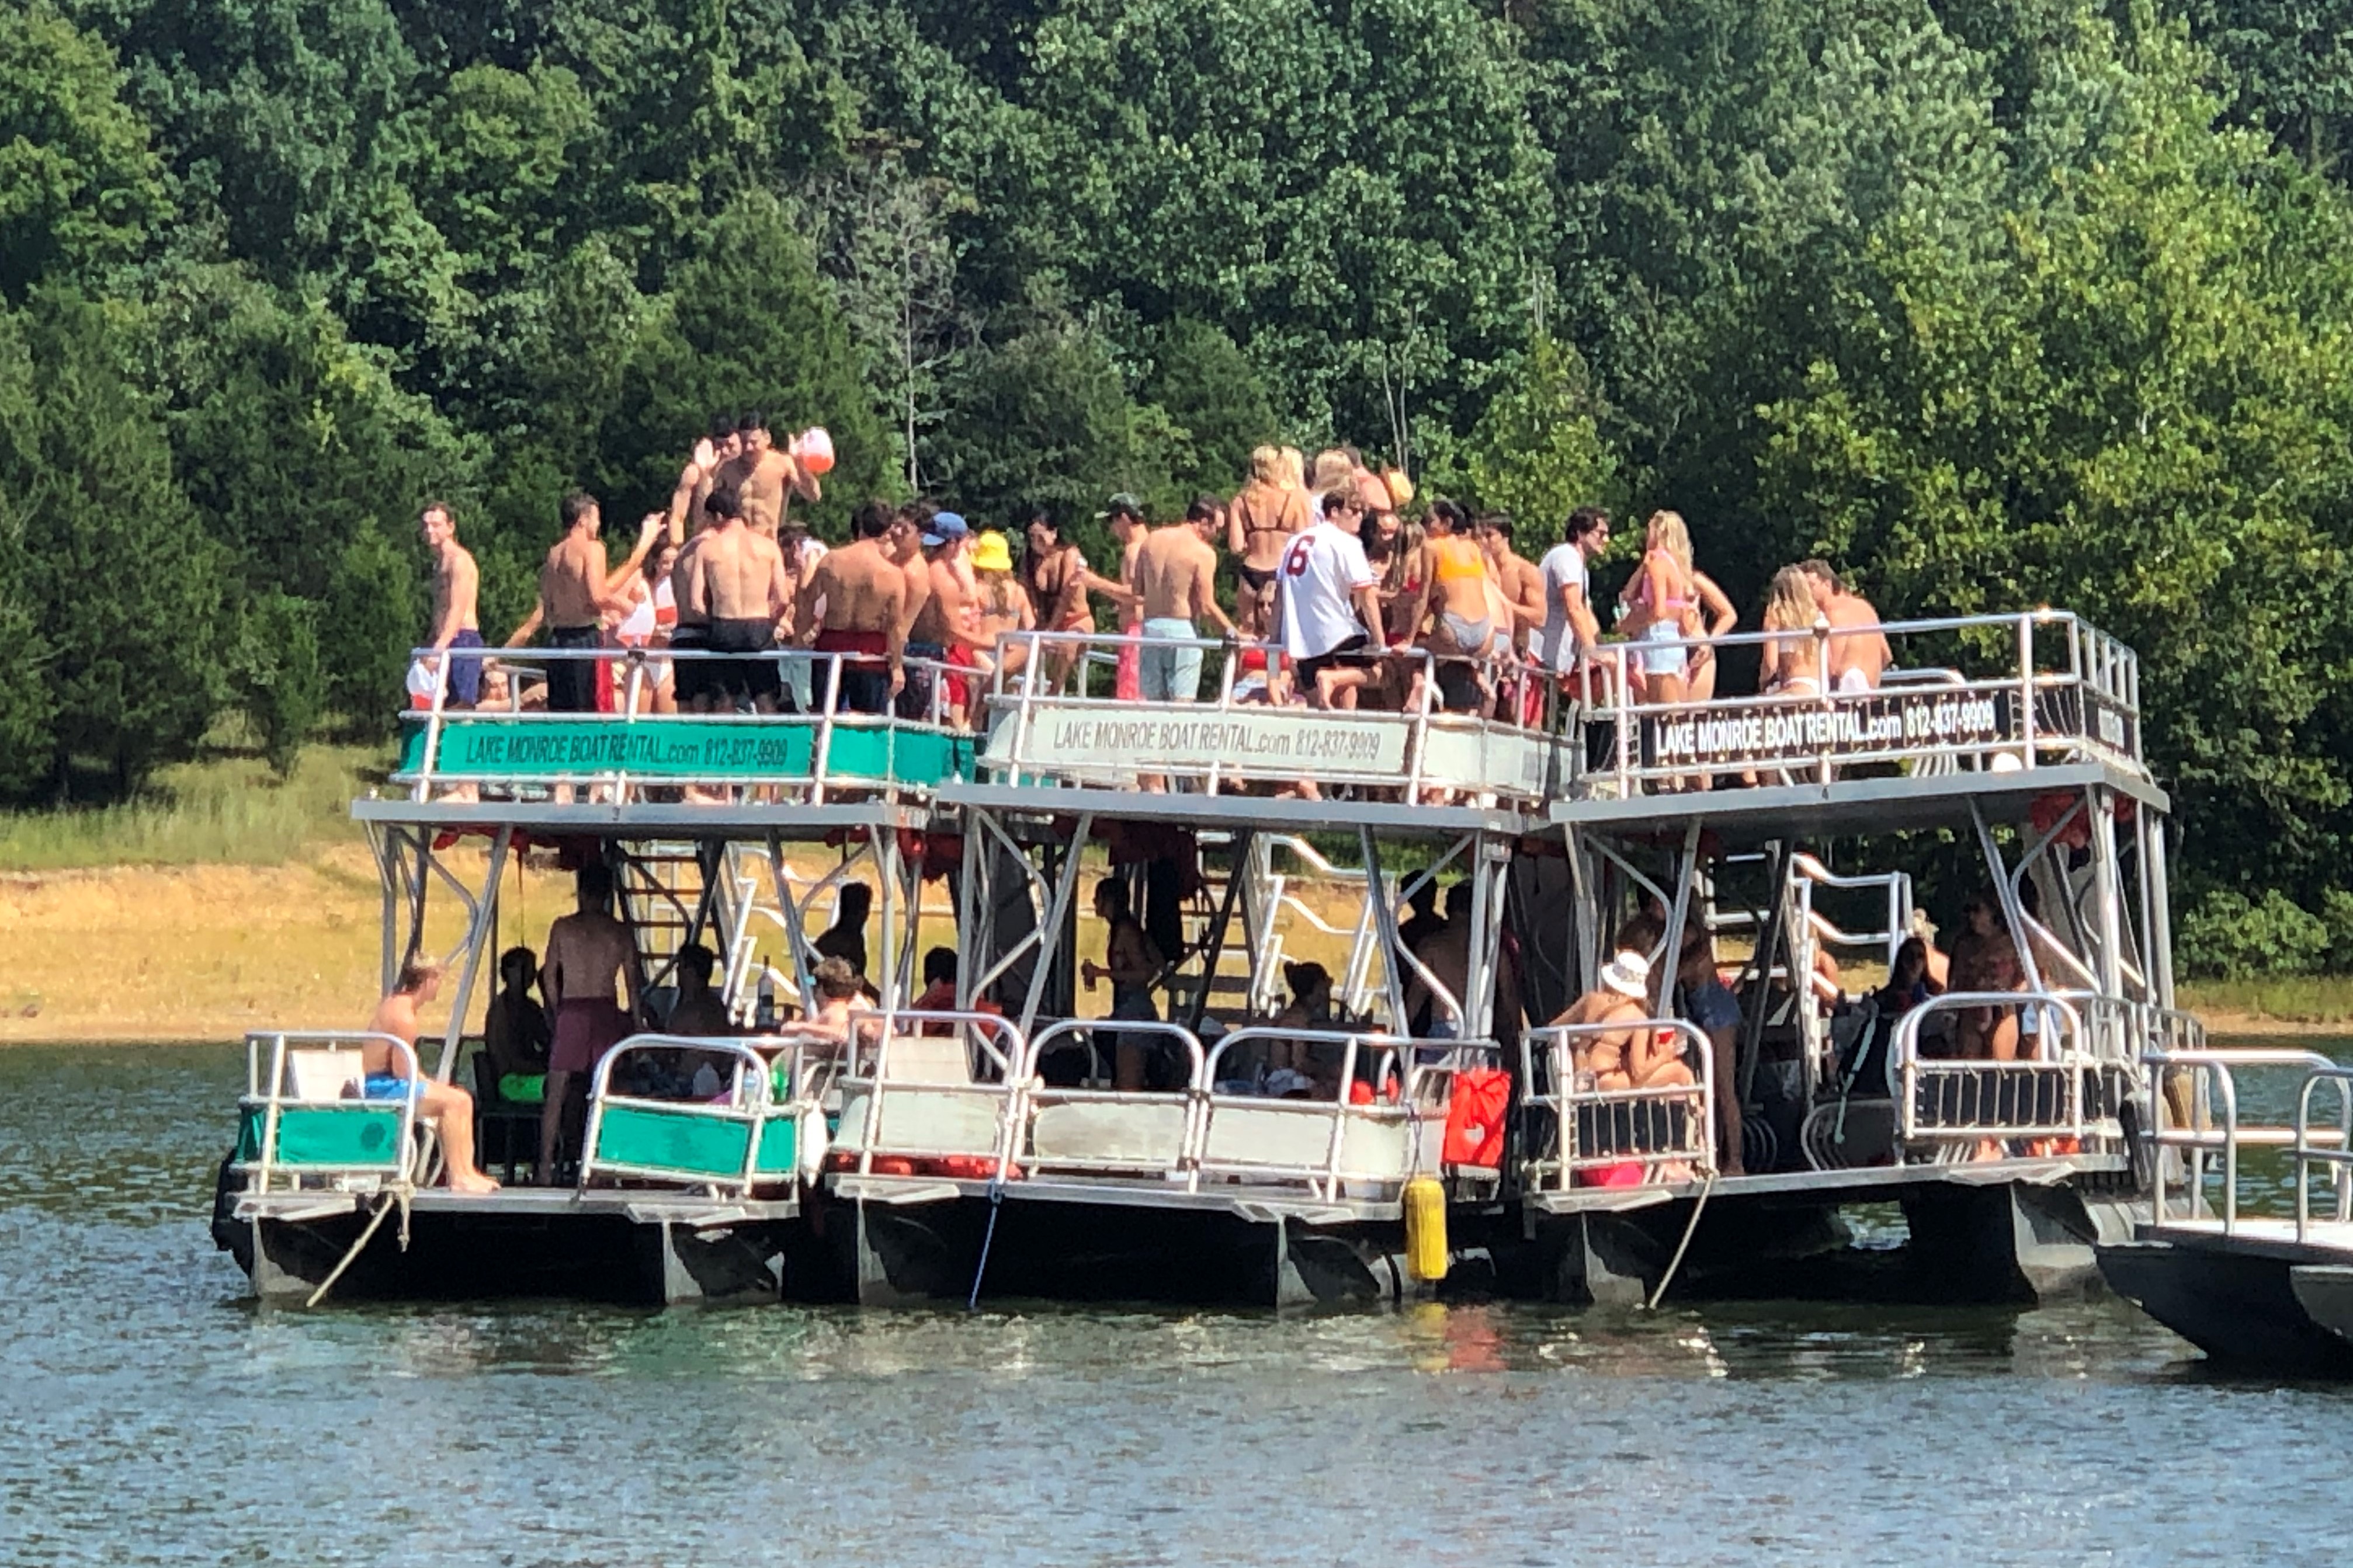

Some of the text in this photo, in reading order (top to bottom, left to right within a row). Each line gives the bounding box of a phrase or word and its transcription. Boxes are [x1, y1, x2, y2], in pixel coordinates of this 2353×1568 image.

[1287, 536, 1315, 576] 6
[1054, 722, 1091, 749] LAKE
[1094, 722, 1156, 750] MONROE
[1656, 722, 1694, 756] LAKE
[1698, 718, 1762, 753] MONROE
[1906, 700, 1995, 738] 812-837-9909
[468, 735, 505, 763] LAKE
[508, 735, 568, 763] MONROE
